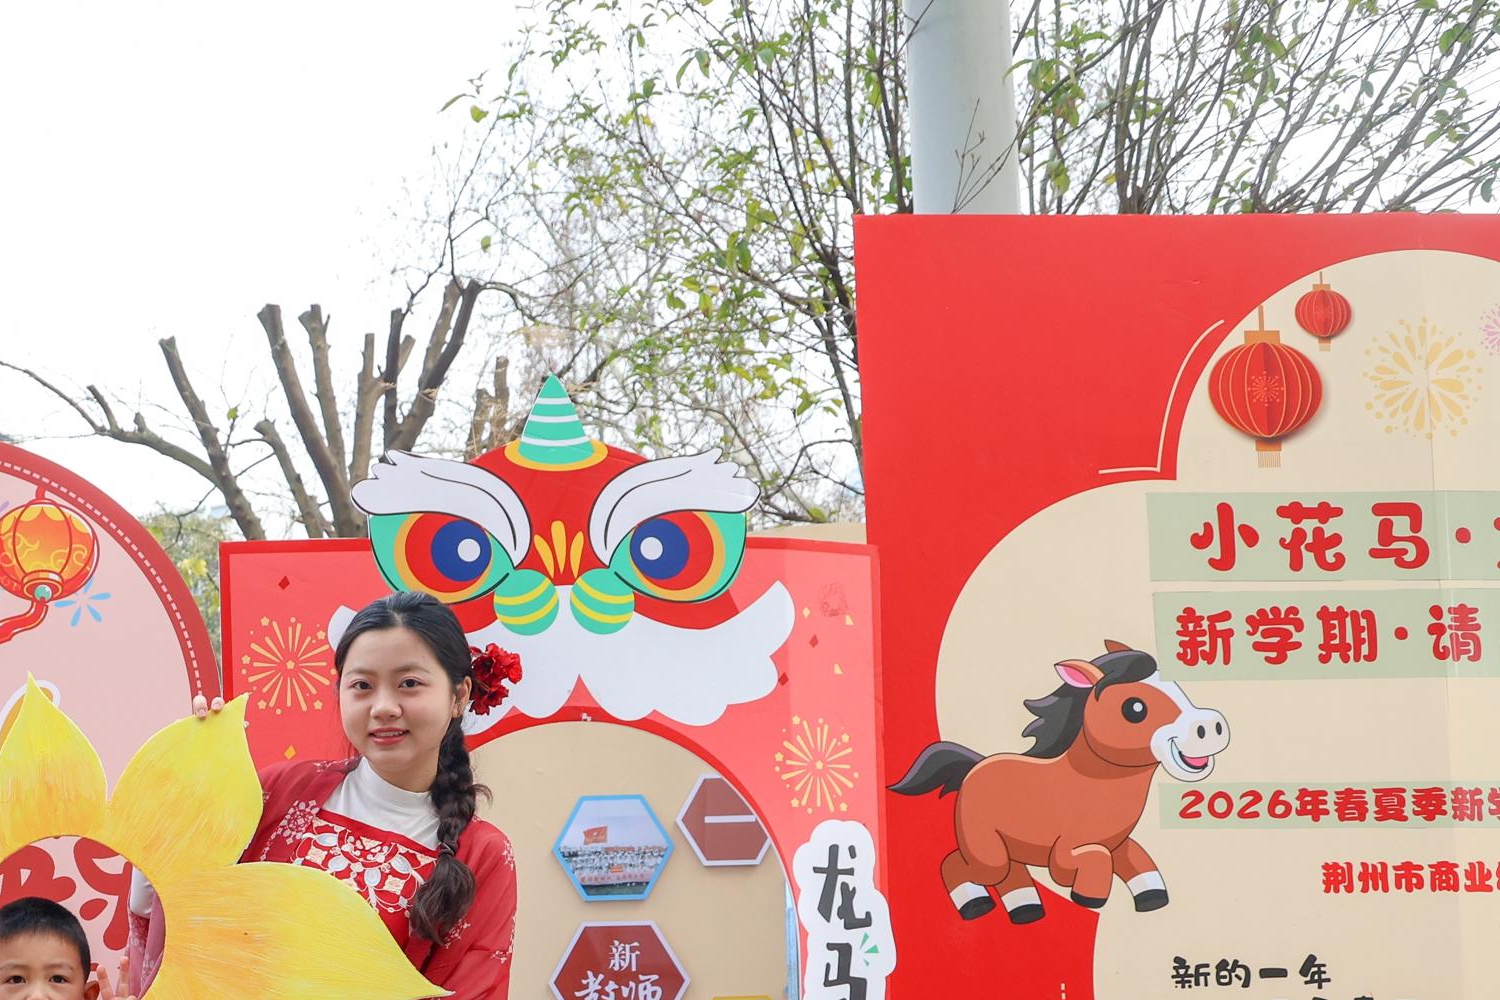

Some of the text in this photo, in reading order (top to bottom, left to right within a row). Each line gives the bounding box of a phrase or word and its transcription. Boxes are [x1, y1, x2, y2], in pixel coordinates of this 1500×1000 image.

[1190, 501, 1500, 571] 小花马·
[1321, 860, 1500, 893] 荆州市商业
[608, 939, 642, 972] 新
[1171, 953, 1332, 990] 新的一年
